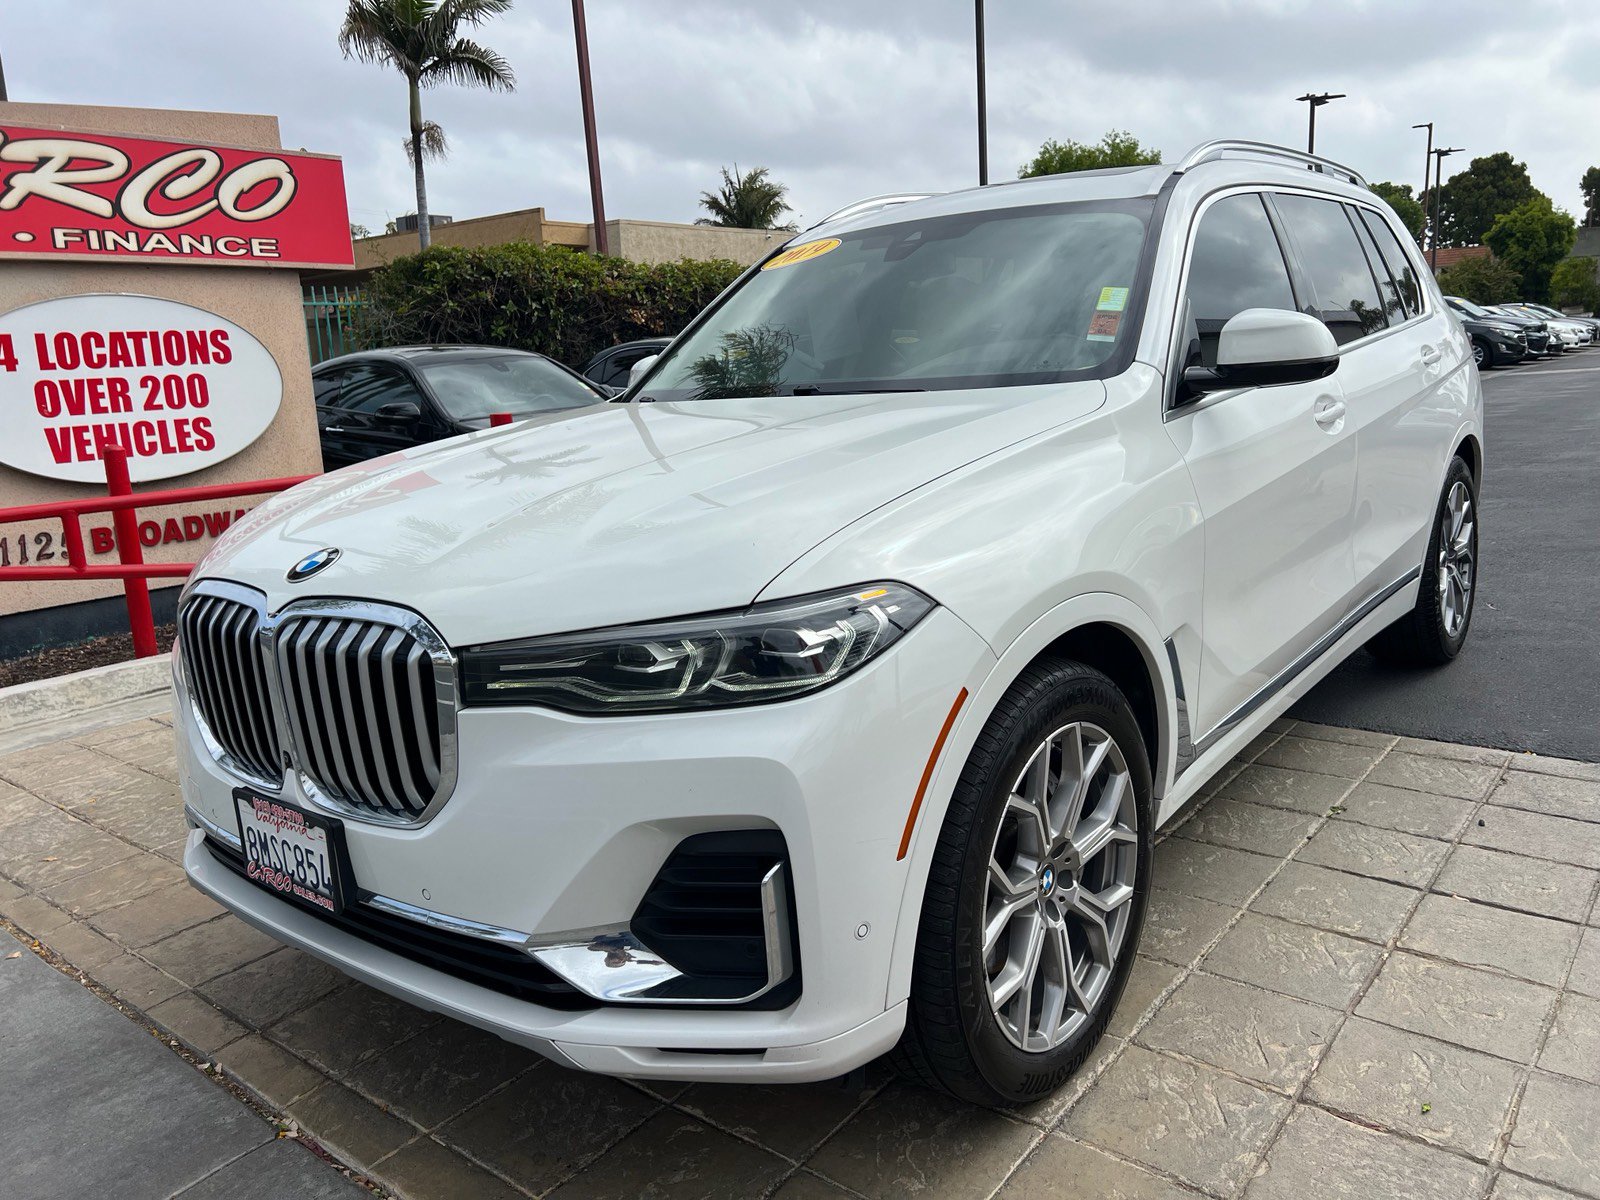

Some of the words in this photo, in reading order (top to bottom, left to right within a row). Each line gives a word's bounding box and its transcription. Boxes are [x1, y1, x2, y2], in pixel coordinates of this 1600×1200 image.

[0, 131, 297, 229] RCO
[51, 227, 281, 258] FINANCE
[0, 333, 18, 372] 4
[34, 329, 233, 371] LOCATIONS
[33, 376, 133, 419] OVER
[139, 373, 210, 411] 200
[44, 416, 216, 464] VEHICLES
[91, 508, 253, 555] BOADW
[255, 809, 315, 840] California
[246, 825, 335, 896] 8MSC854
